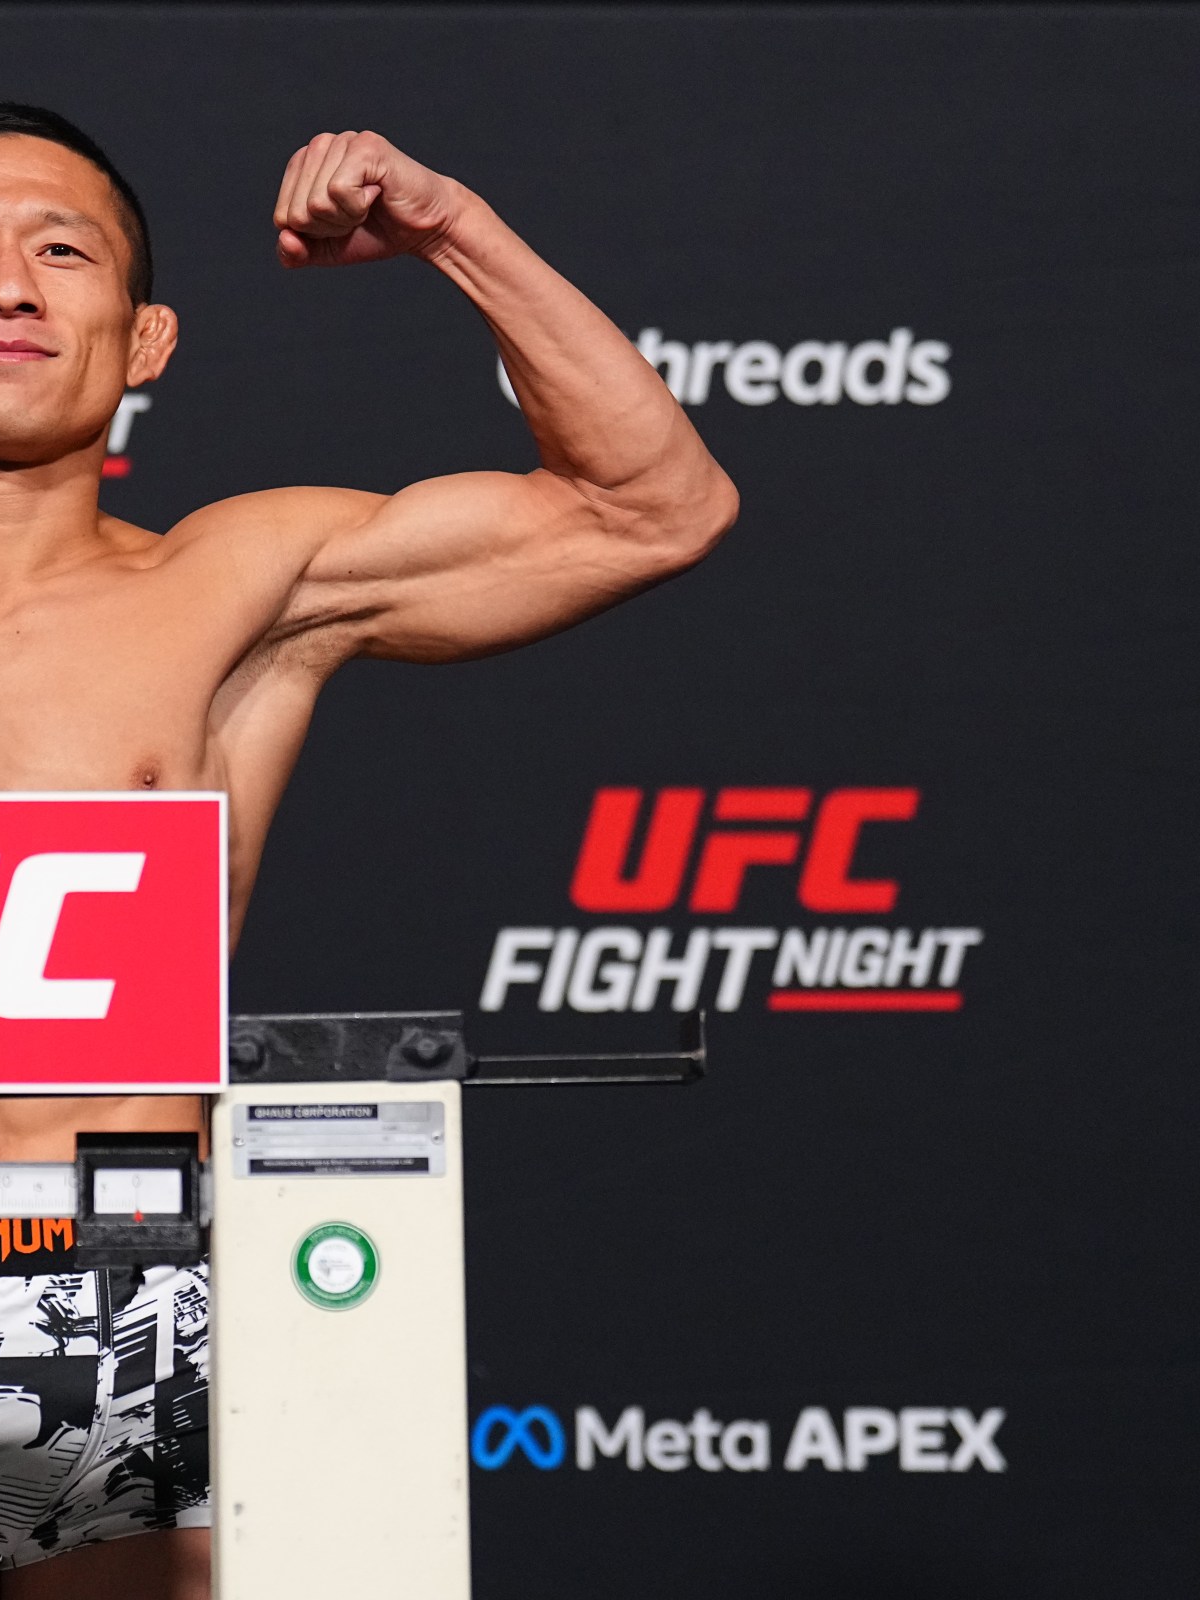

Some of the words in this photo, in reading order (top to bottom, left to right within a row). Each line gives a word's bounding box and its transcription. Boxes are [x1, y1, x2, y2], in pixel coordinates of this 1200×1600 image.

[634, 326, 951, 406] hreads
[569, 787, 921, 914] UFC
[478, 926, 778, 1013] FIGHT
[772, 927, 983, 988] NIGHT
[294, 1105, 373, 1118] CORPORATION
[574, 1405, 771, 1472] Meta
[784, 1407, 1006, 1473] APEX
